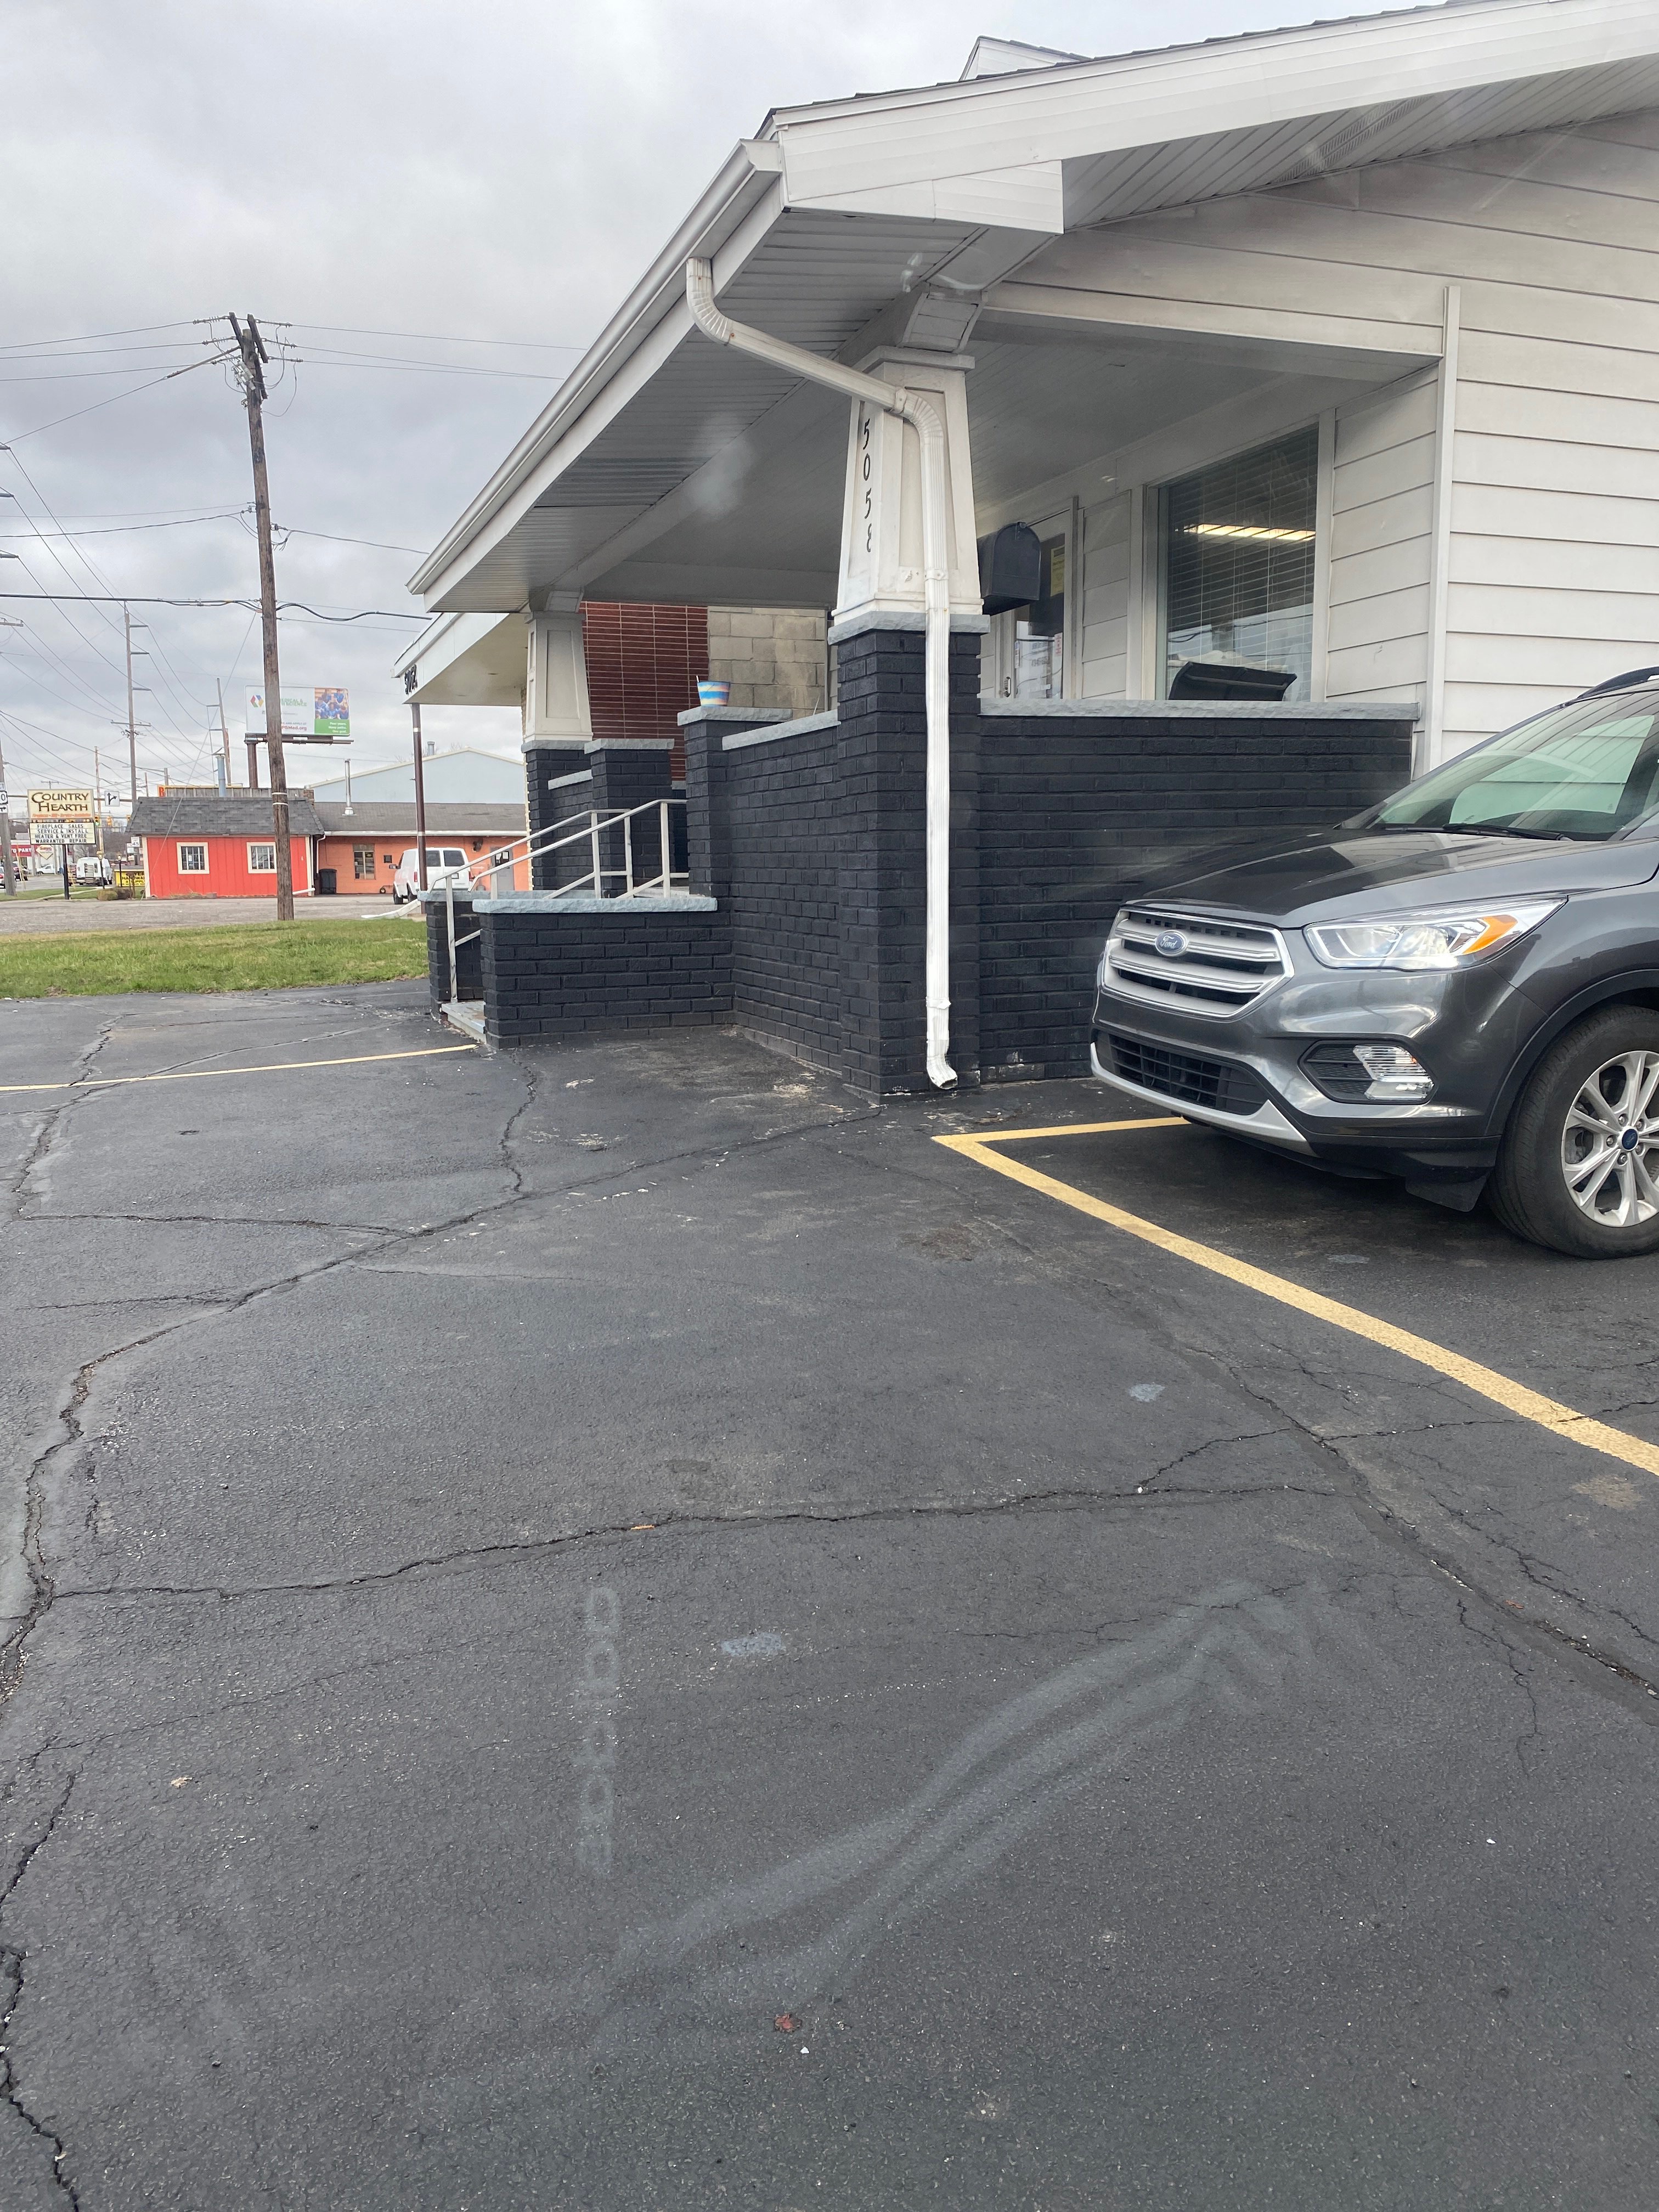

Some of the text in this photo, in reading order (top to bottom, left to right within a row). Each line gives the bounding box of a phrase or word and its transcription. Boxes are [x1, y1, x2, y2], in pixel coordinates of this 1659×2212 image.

[31, 792, 89, 803] COUNTRY
[38, 803, 88, 811] HEARTH
[1160, 935, 1178, 949] Ford
